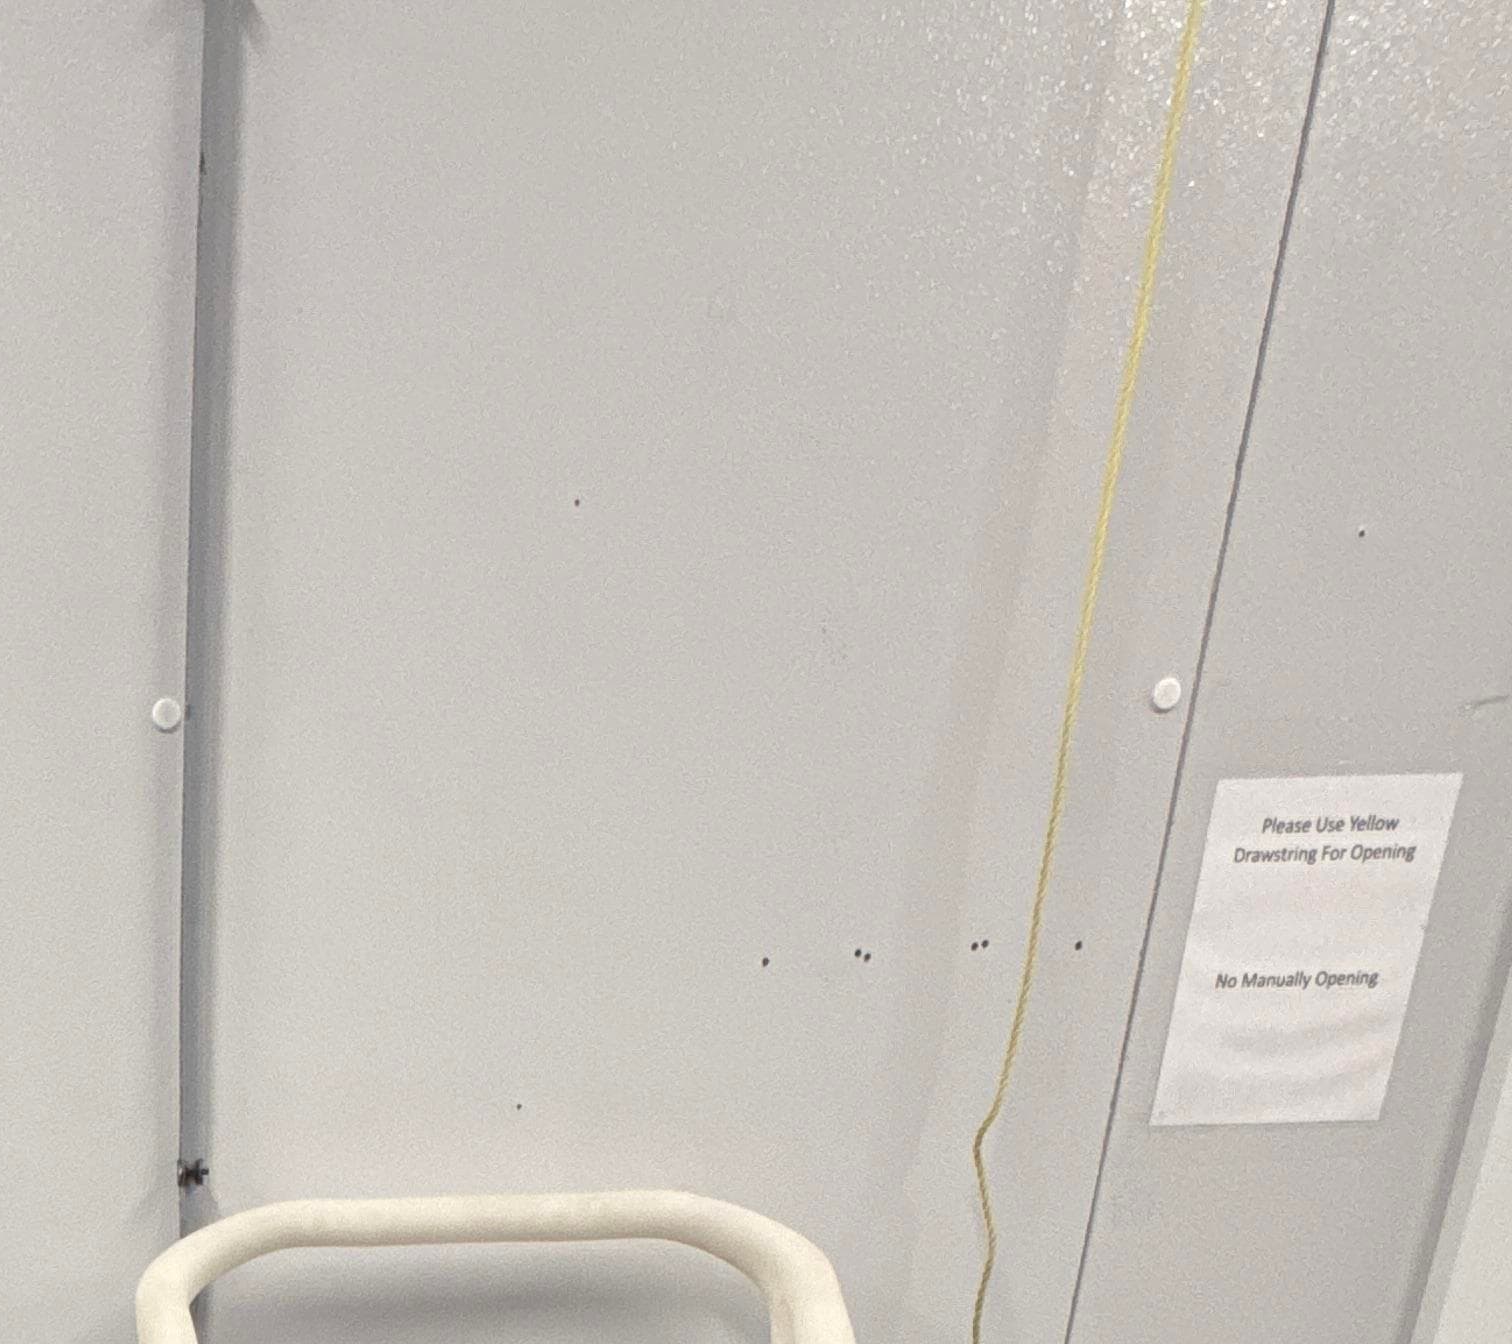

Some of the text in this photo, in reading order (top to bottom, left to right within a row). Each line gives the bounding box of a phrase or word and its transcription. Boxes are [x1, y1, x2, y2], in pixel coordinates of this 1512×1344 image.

[1261, 814, 1400, 834] Please Use Yellow
[1233, 843, 1417, 865] Drawstring For Opening
[1215, 970, 1379, 990] No Manually Opening
